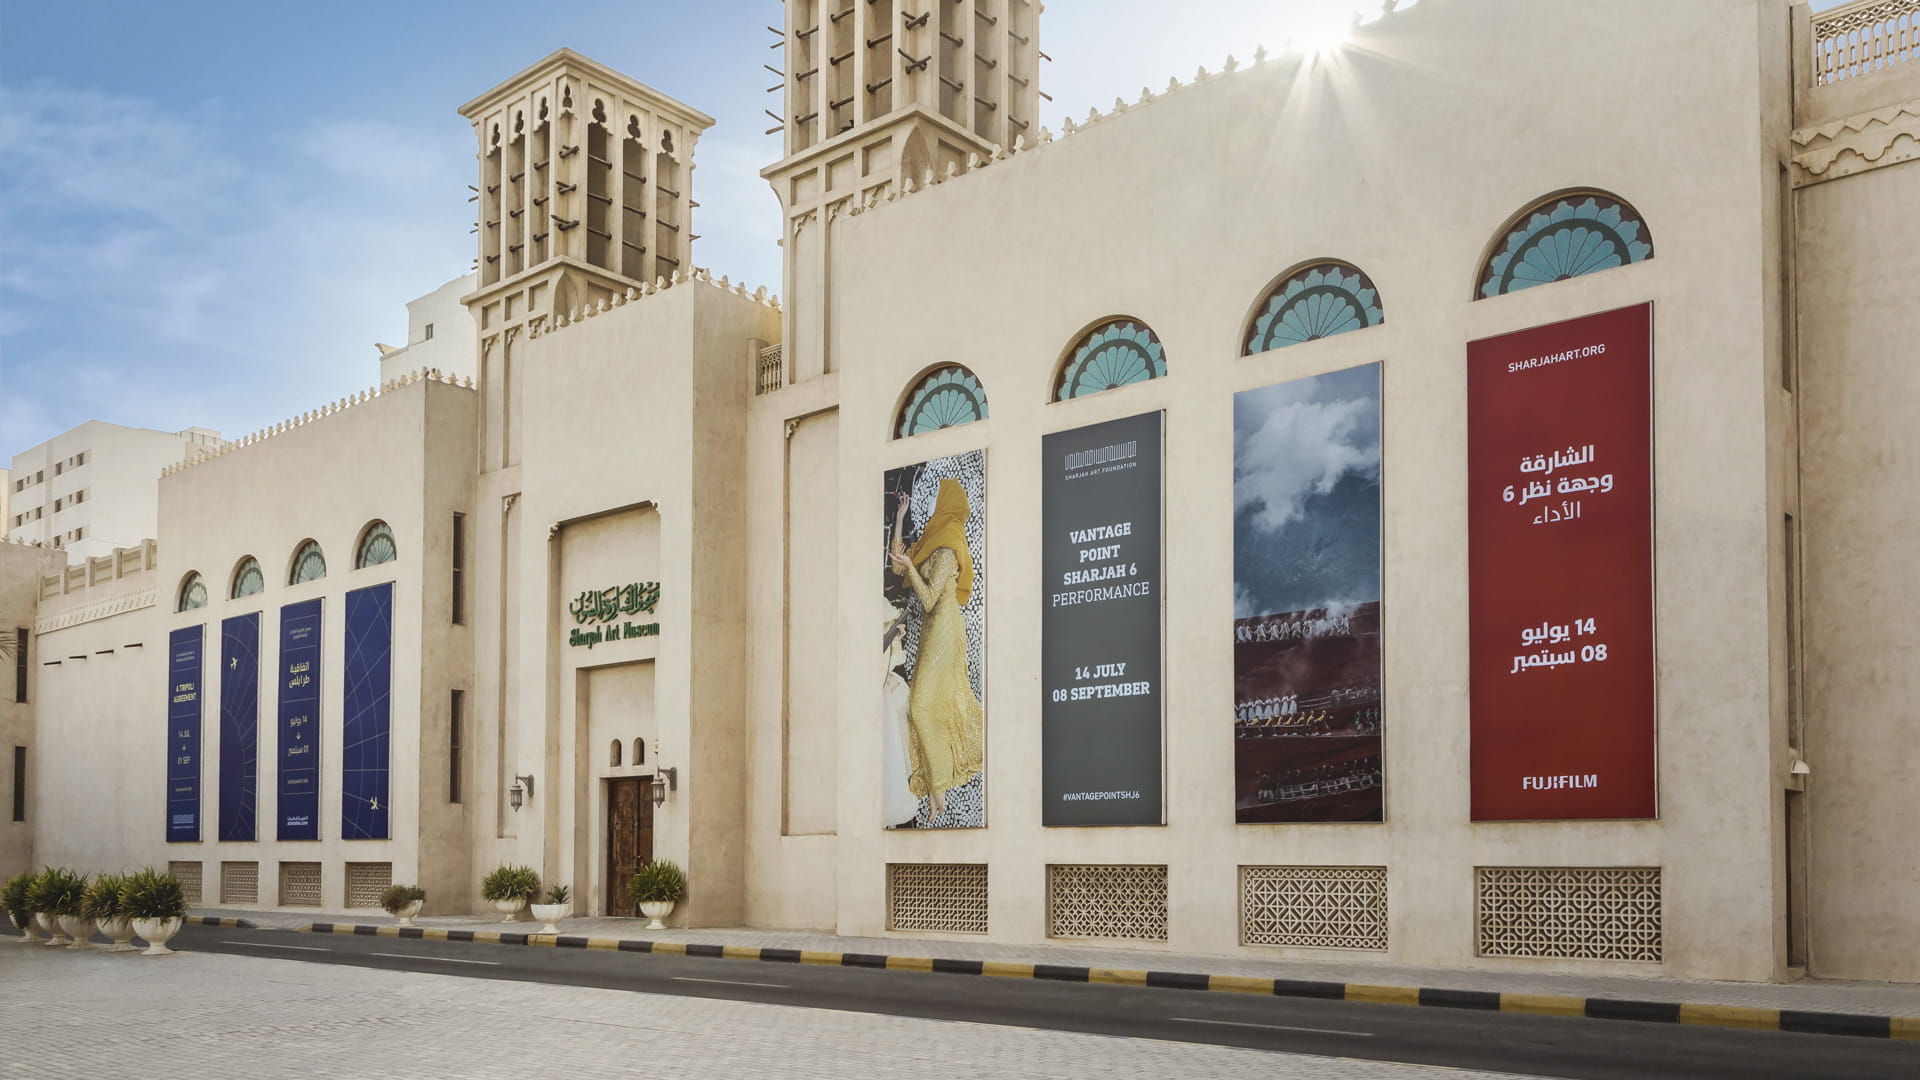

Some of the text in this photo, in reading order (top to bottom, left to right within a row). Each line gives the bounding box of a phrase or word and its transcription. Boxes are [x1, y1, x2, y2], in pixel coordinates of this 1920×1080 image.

[1508, 344, 1606, 373] SHARJAHART.ORG
[1065, 461, 1137, 481] SHARJAH ART FOUNDATION
[1520, 445, 1594, 475] الشارقة
[1503, 474, 1613, 506] وجهة نظر 6
[1533, 501, 1581, 525] الأداء
[1070, 522, 1132, 544] VANTAGE
[1080, 544, 1121, 563] POINT
[1063, 562, 1138, 586] SHARJAH 6
[1052, 581, 1150, 607] PERFORMANCE
[605, 624, 620, 641] Art
[623, 621, 660, 639] Museum
[1521, 618, 1596, 646] 14 يوليو
[1510, 644, 1608, 674] 08 سبتمبر
[1075, 663, 1126, 680] 14 JULY
[1052, 681, 1150, 702] 08 SEPTEMBER
[1522, 774, 1598, 790] FUJIFILM
[1063, 791, 1140, 801] #VANTAGEPOINTSHJ6
